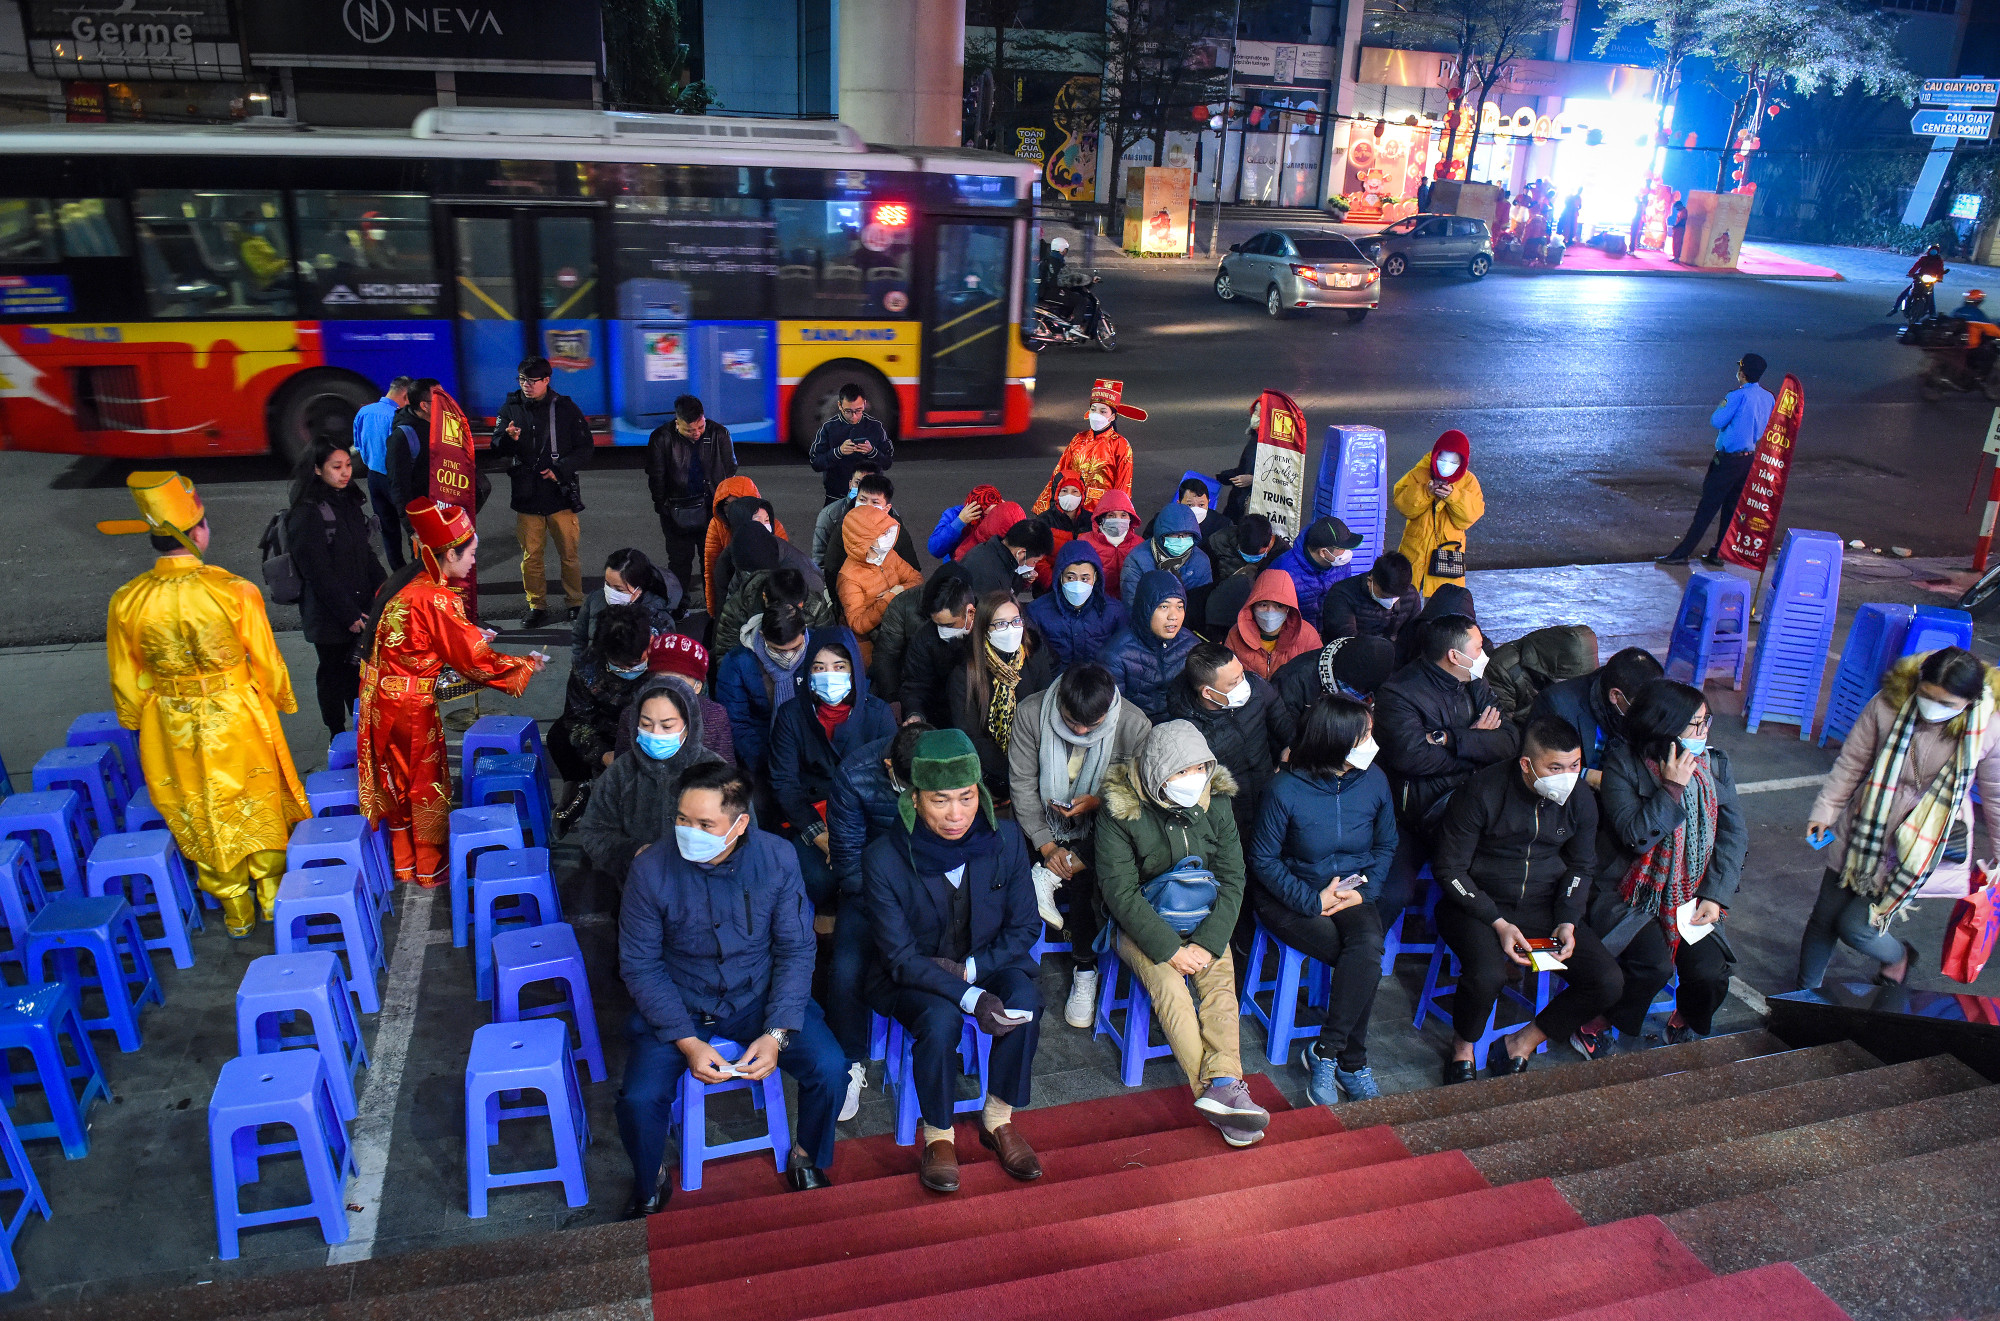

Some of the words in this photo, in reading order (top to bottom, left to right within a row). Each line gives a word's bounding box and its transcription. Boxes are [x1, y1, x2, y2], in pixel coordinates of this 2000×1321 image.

[404, 7, 503, 35] NEVA
[71, 15, 193, 45] Germe
[1924, 82, 1943, 91] CAU
[1943, 83, 1965, 92] GIAY
[1965, 83, 1996, 93] HOTEL
[1945, 113, 1966, 123] CAU
[1966, 114, 1989, 124] GIAY
[1922, 123, 1958, 133] CENTER
[1957, 125, 1987, 135] POINT
[1286, 162, 1318, 170] SAMSUNG
[1766, 430, 1790, 449] GOLD
[442, 458, 461, 471] BTMC
[1274, 454, 1293, 464] BTMC
[1760, 452, 1784, 469] TRUNG
[436, 468, 469, 489] GOLD
[1758, 468, 1775, 483] TÂM
[440, 486, 461, 496] CENTER
[1751, 481, 1774, 497] VÀNG
[1263, 491, 1293, 507] TRUNG
[1746, 497, 1770, 512] BTMC
[1266, 511, 1287, 526] TÂM
[1736, 531, 1763, 550] 139
